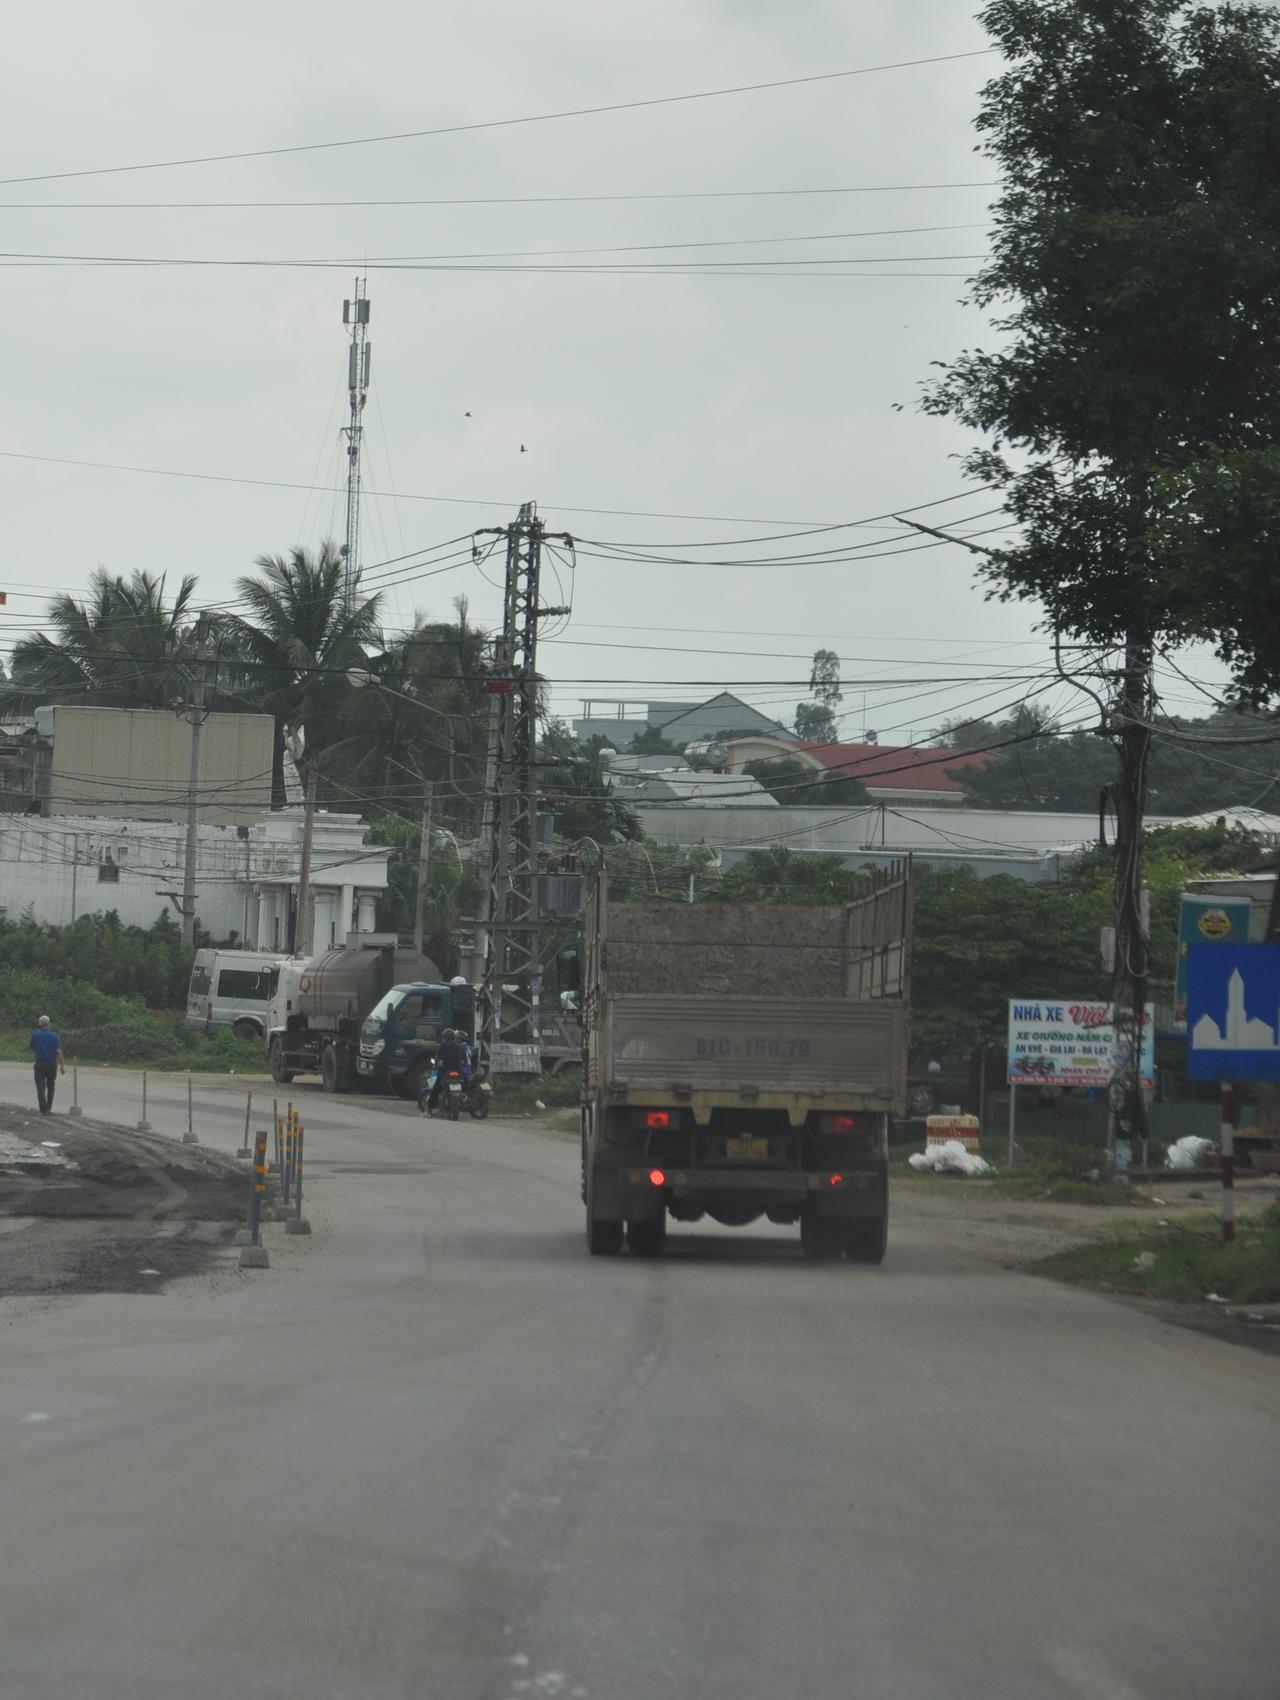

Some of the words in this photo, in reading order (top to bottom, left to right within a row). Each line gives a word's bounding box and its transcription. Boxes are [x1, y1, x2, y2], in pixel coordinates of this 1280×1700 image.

[1013, 1003, 1042, 1021] NHÀ
[1046, 1006, 1063, 1021] XE
[1016, 1031, 1030, 1040] XE
[1015, 1045, 1026, 1053] AN
[1028, 1044, 1043, 1054] KHÊ
[1049, 1045, 1063, 1054] GIA
[1064, 1046, 1076, 1054] LAI
